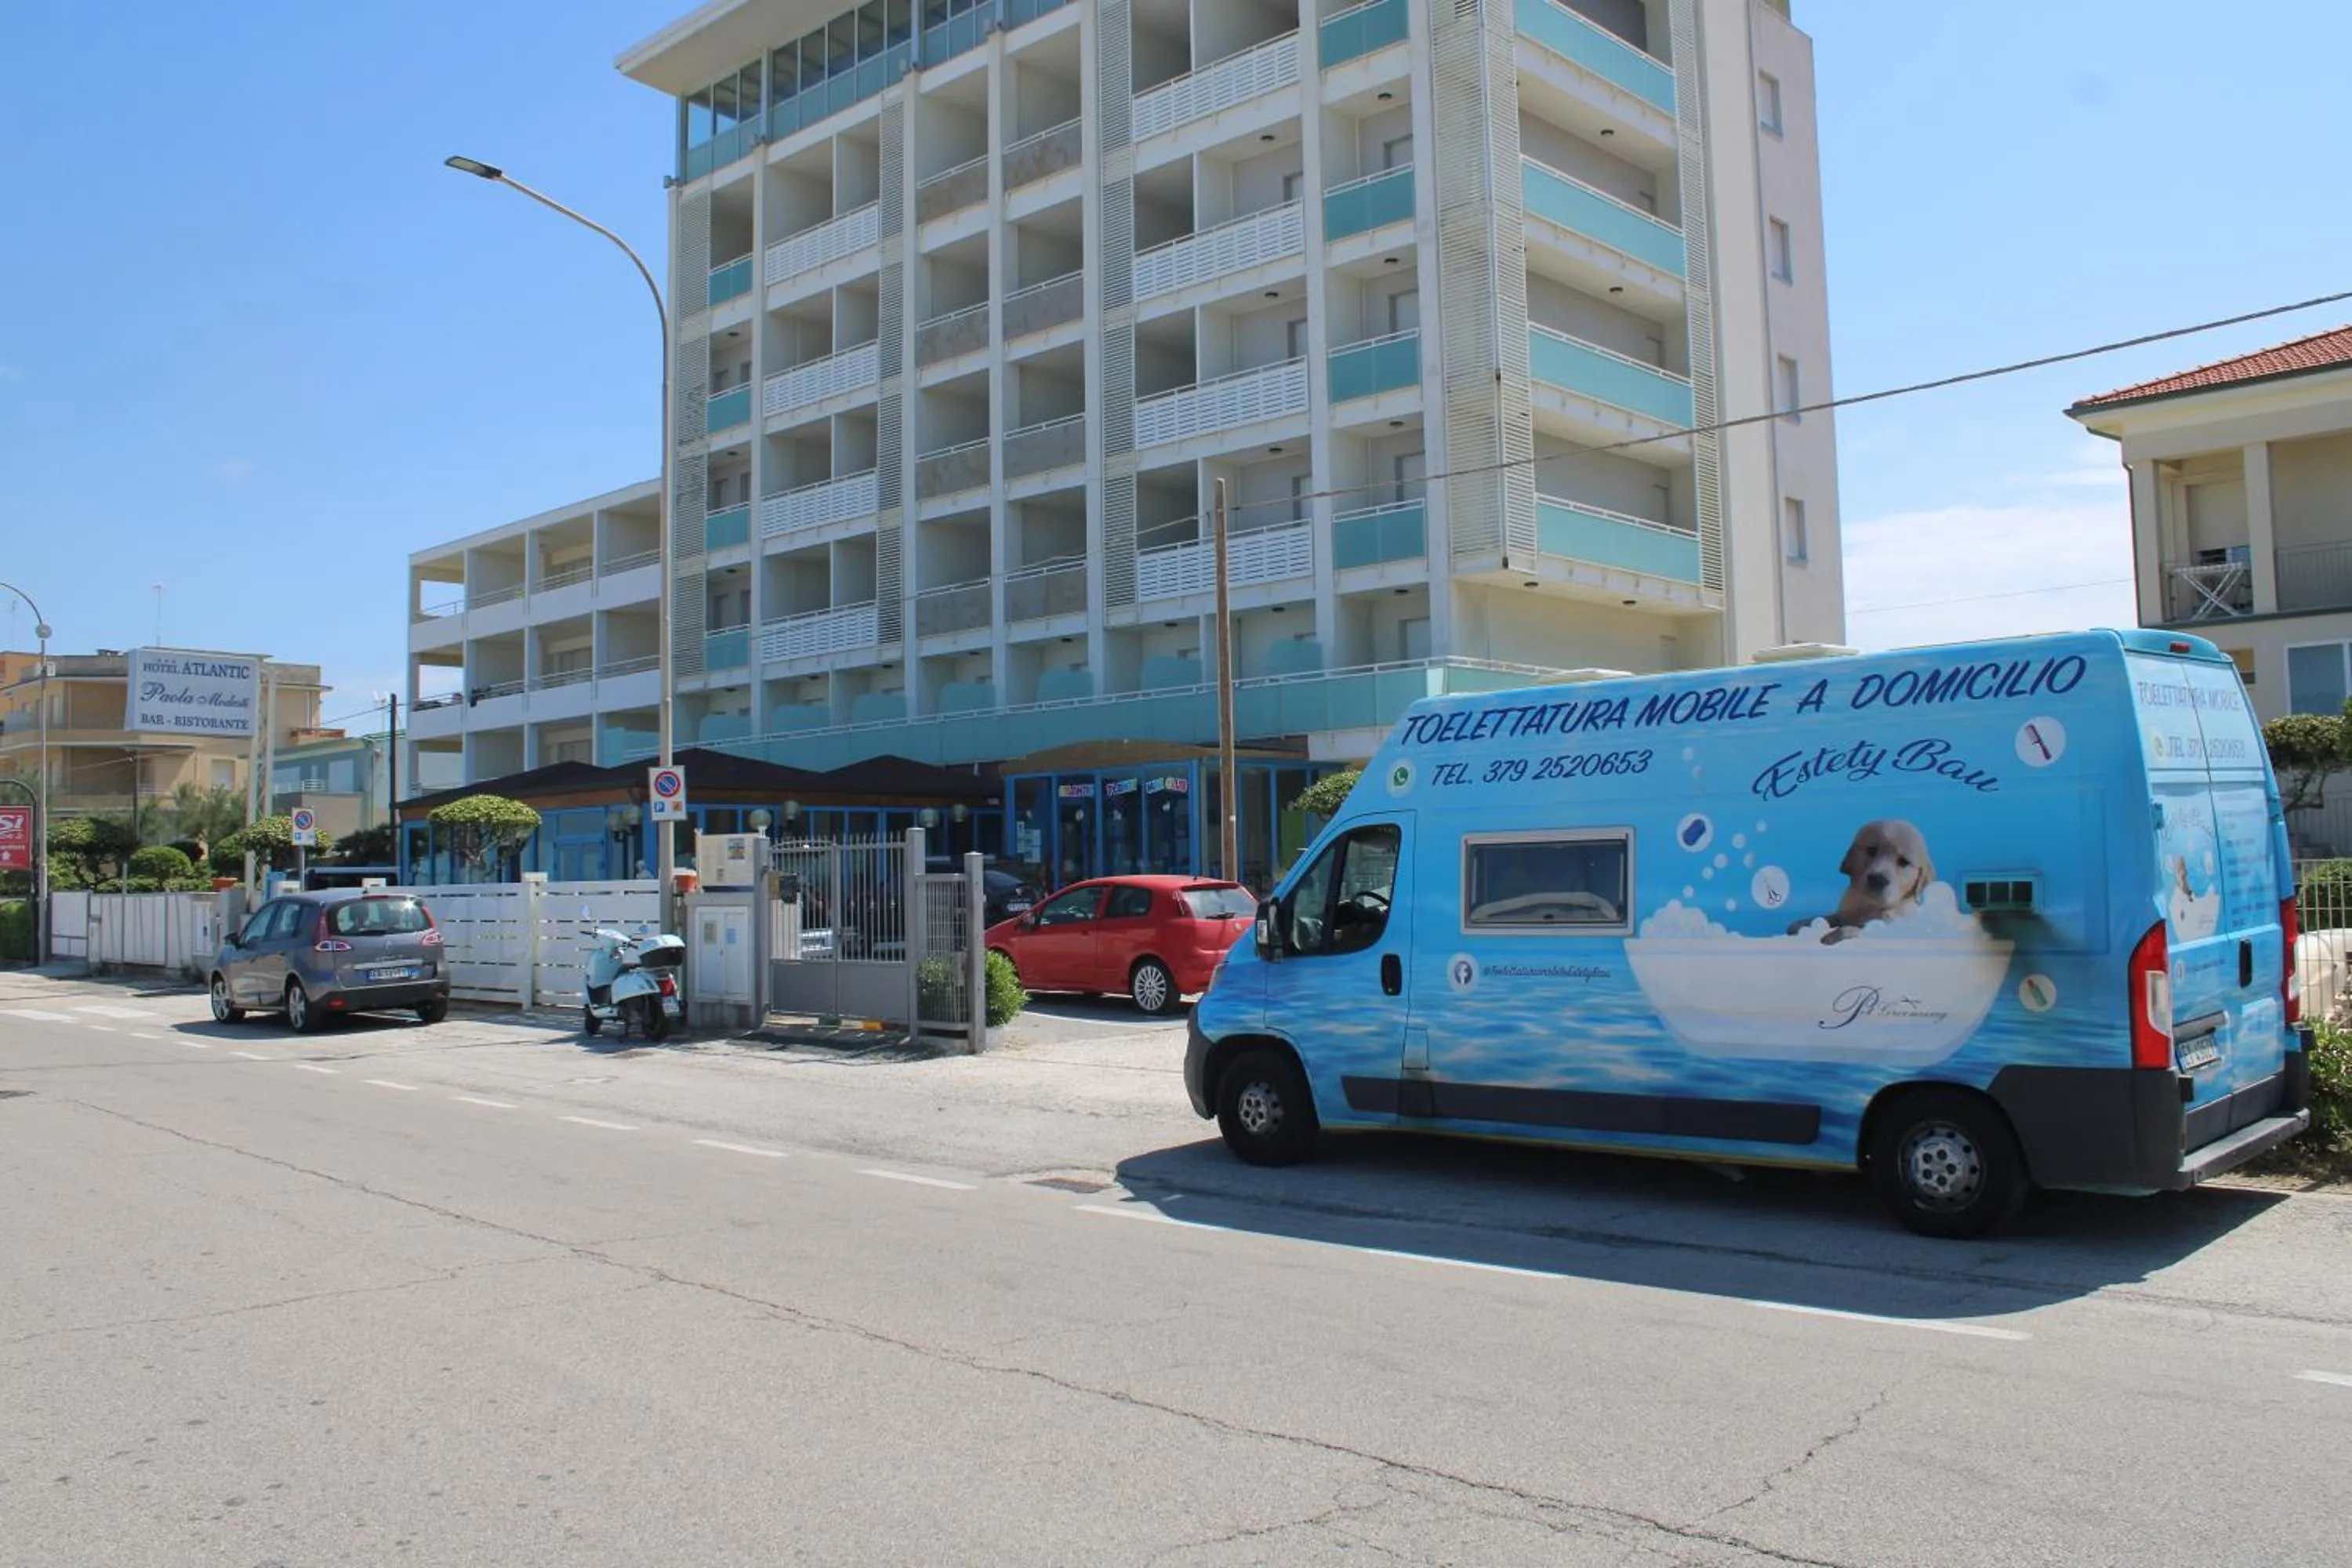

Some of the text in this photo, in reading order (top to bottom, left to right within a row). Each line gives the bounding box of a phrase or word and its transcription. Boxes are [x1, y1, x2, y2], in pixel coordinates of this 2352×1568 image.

[143, 661, 250, 680] HOTEL ATLANTIC
[140, 681, 194, 704] Paola
[1401, 655, 2088, 746] TOELETTATURA MOBILE A DOMICILIO
[140, 713, 165, 725] BAR
[175, 714, 249, 730] RISTORANTE
[1432, 749, 1653, 786] TEL. 379 2520653
[1751, 738, 1999, 801] Estety Bau
